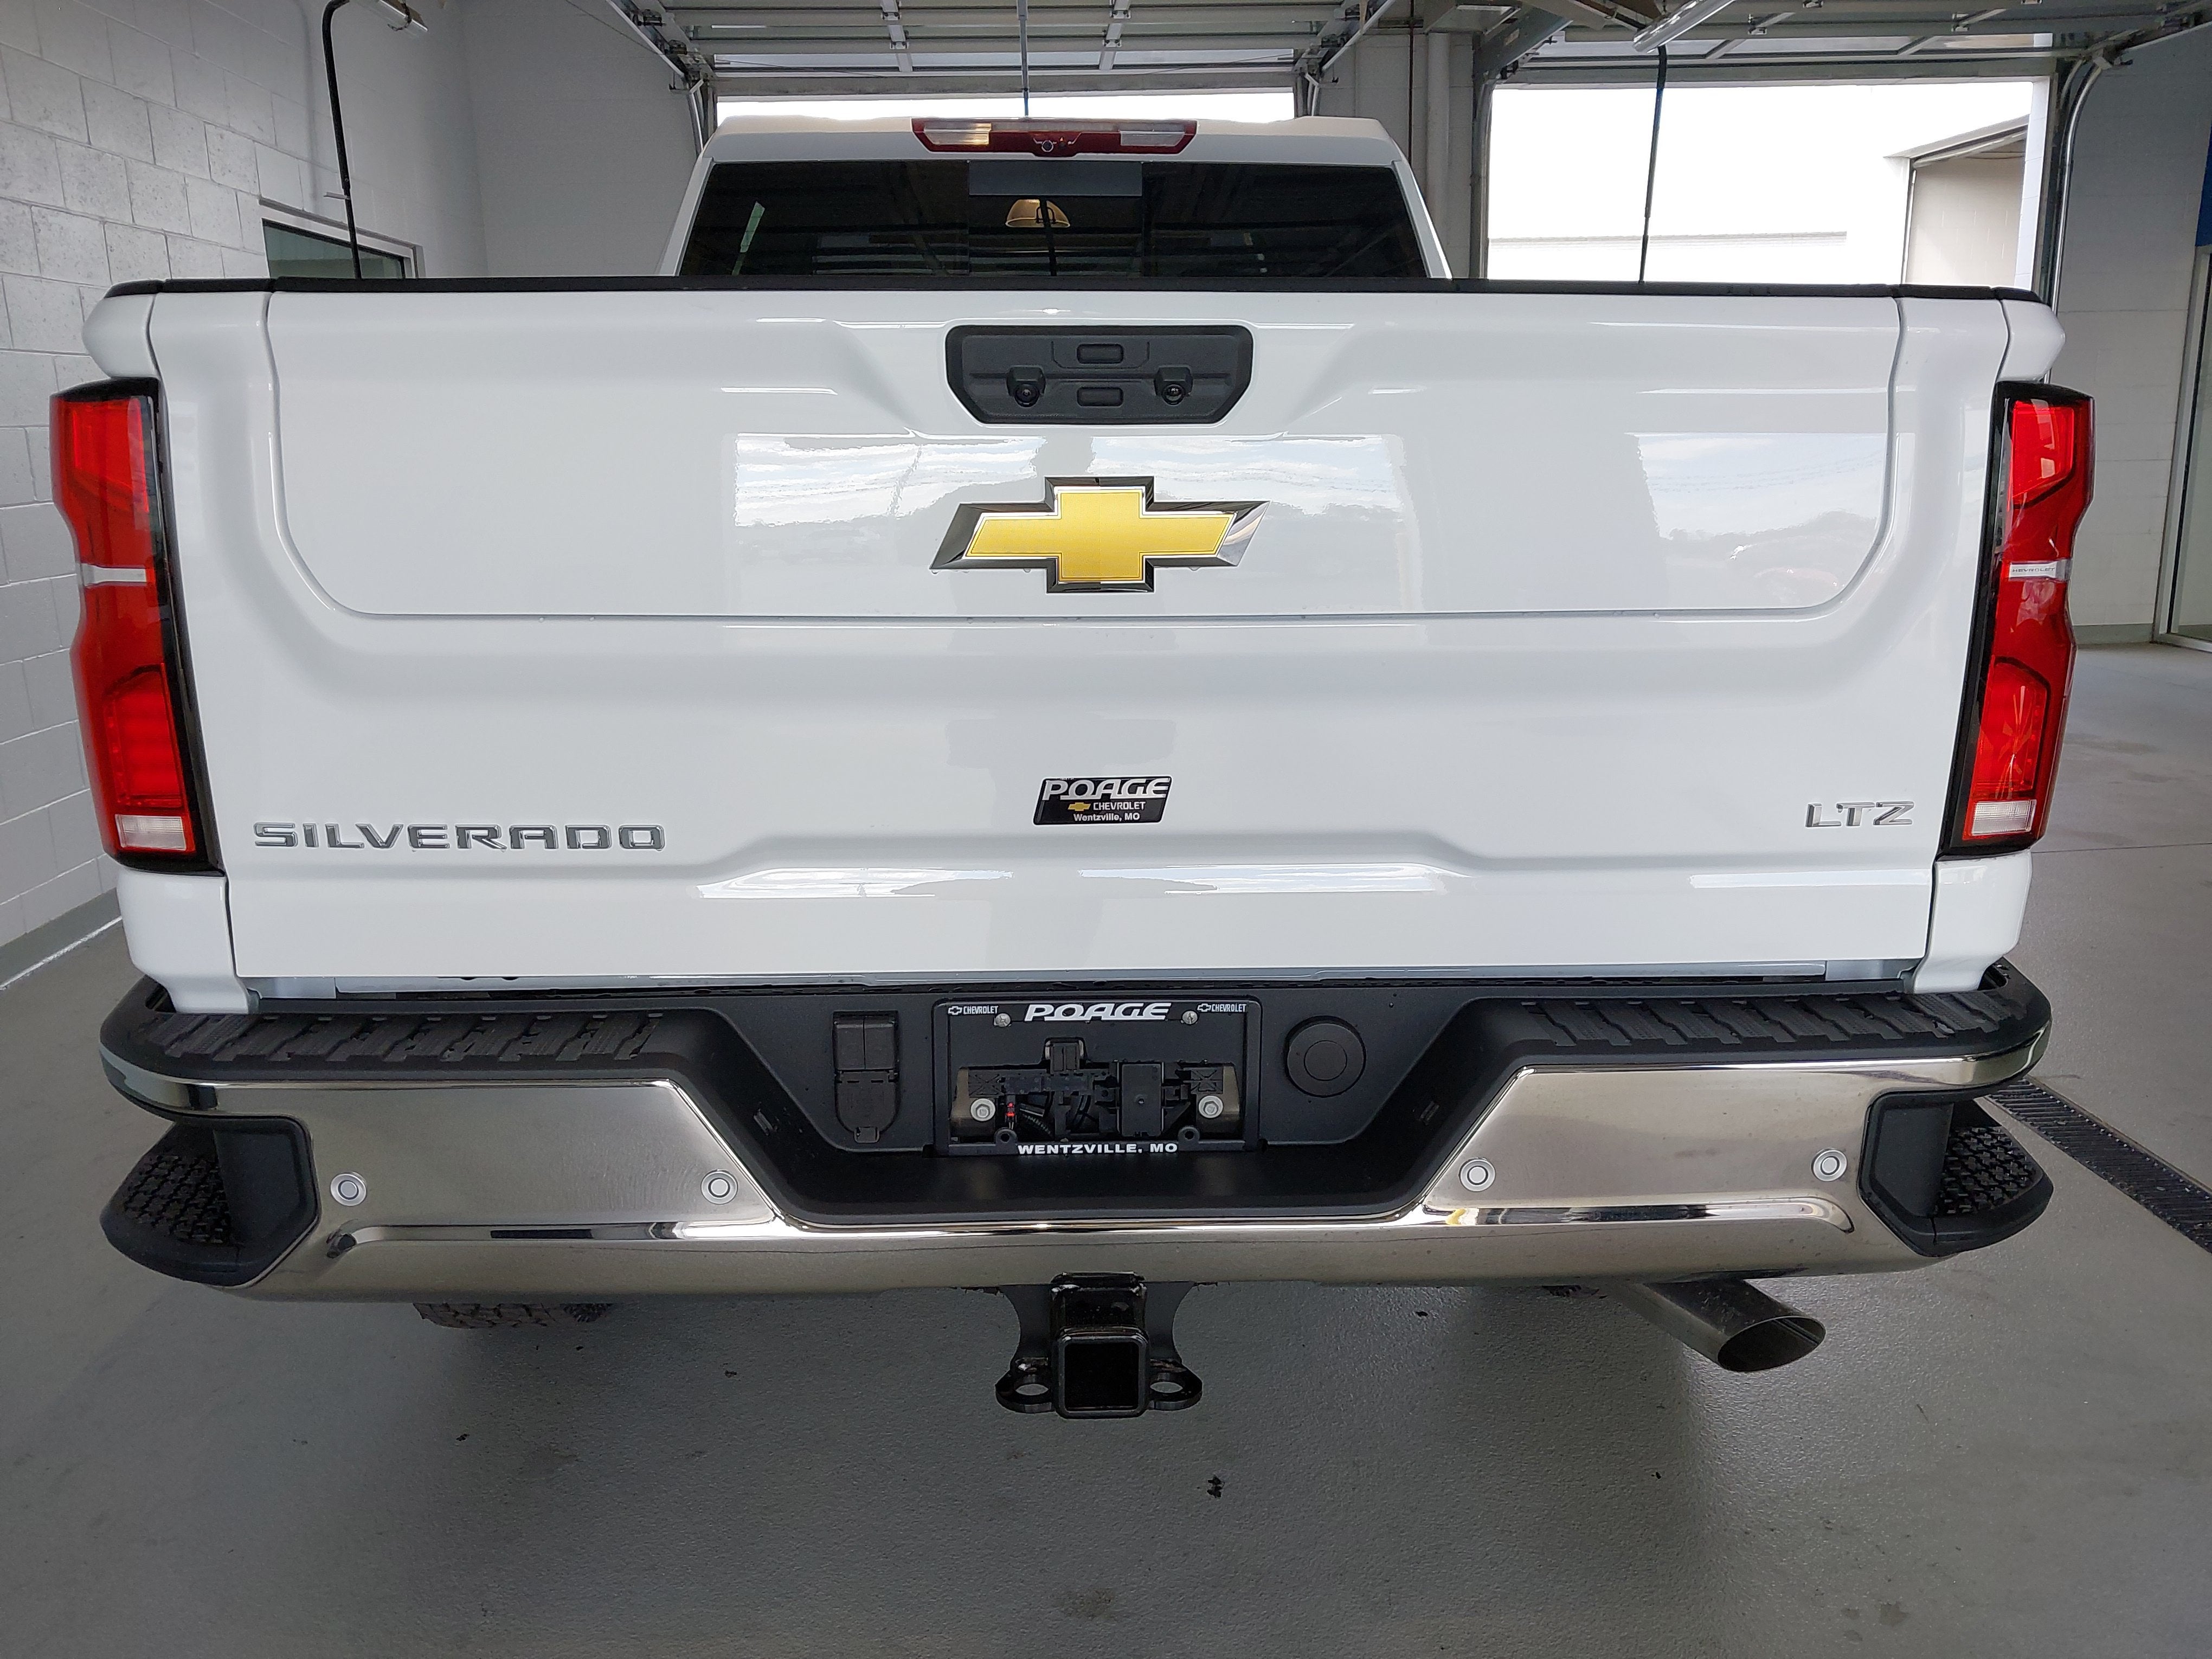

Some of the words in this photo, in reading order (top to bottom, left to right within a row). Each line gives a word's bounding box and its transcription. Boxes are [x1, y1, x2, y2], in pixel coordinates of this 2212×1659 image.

[1042, 777, 1170, 801] POAGE
[1093, 801, 1146, 811] CHEVROLET
[1073, 813, 1122, 821] Wentzville,
[1124, 812, 1140, 820] MO
[1805, 801, 1915, 827] LTZ
[253, 822, 665, 850] SILVERADO
[963, 1005, 999, 1014] CHEVROLET
[1024, 1003, 1172, 1021] POAGE
[1211, 1003, 1248, 1012] CHEVROLET
[1018, 1143, 1142, 1154] WENTZVILLE,
[1150, 1143, 1178, 1153] MO
